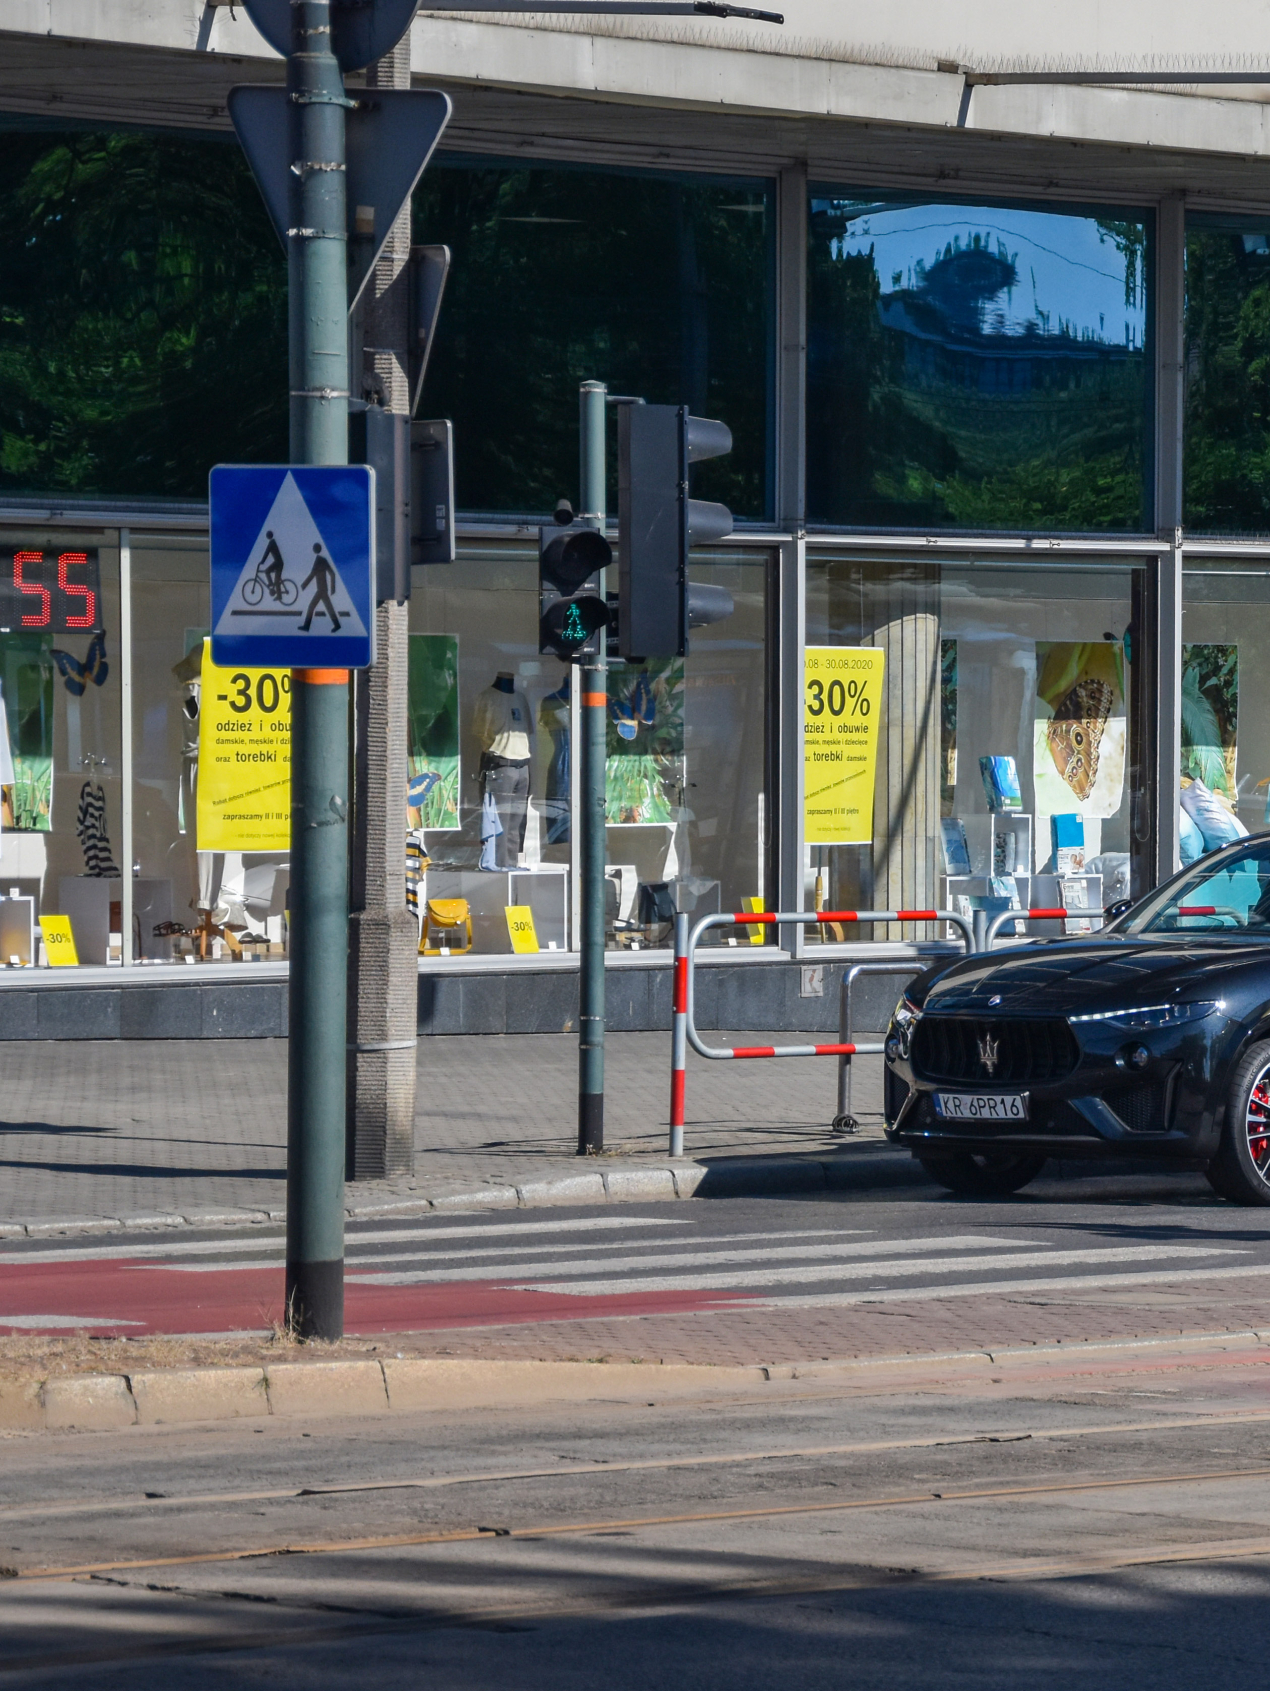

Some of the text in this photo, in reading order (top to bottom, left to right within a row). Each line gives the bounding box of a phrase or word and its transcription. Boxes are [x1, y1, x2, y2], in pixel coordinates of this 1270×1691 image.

[826, 659, 873, 670] 30.08.2020
[804, 679, 870, 716] 30%
[216, 720, 252, 732] odzież
[260, 720, 262, 732] i
[804, 722, 868, 734] dzież i obuwie
[235, 750, 276, 762] torebki
[813, 750, 843, 762] torebki
[222, 813, 263, 821] zapraszamy
[511, 921, 532, 931] -30%
[46, 933, 70, 943] -30%
[942, 1096, 1020, 1116] KR 6PR16
